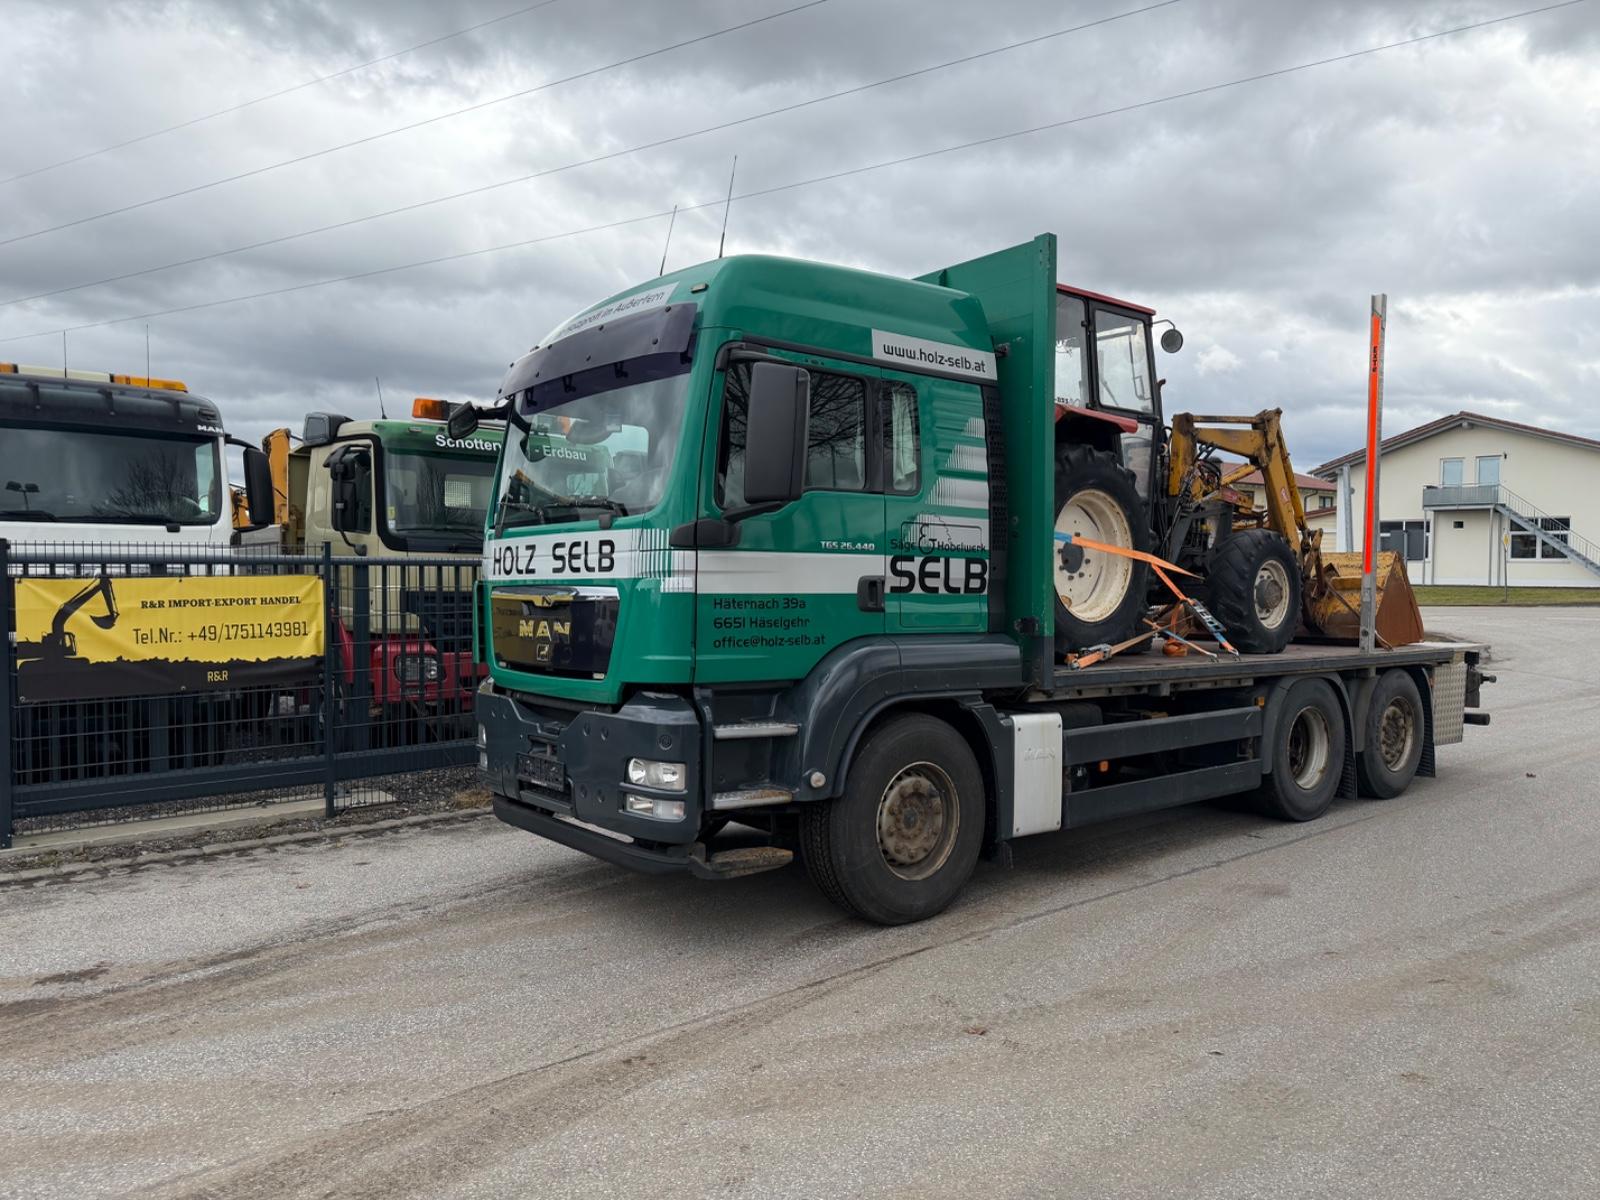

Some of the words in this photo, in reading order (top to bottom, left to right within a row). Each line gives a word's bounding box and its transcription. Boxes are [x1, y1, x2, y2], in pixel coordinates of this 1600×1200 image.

[883, 343, 986, 373] www.holz-selb.at
[543, 445, 587, 461] Erdbau
[493, 544, 536, 576] HOLZ
[552, 539, 615, 574] SELB
[890, 555, 988, 594] SELB
[141, 600, 166, 609] R&R
[168, 597, 257, 608] IMPORT-EXPORT
[260, 595, 302, 606] HANDEL
[713, 597, 780, 610] Häternach
[783, 597, 807, 610] 39a
[519, 619, 571, 643] MAN
[749, 616, 810, 631] Häselgehr
[133, 627, 182, 645] Tel.Nr.:
[187, 621, 309, 643] +49/1751143981
[713, 634, 826, 649] office@holz-selb.at
[207, 670, 229, 683] R&R
